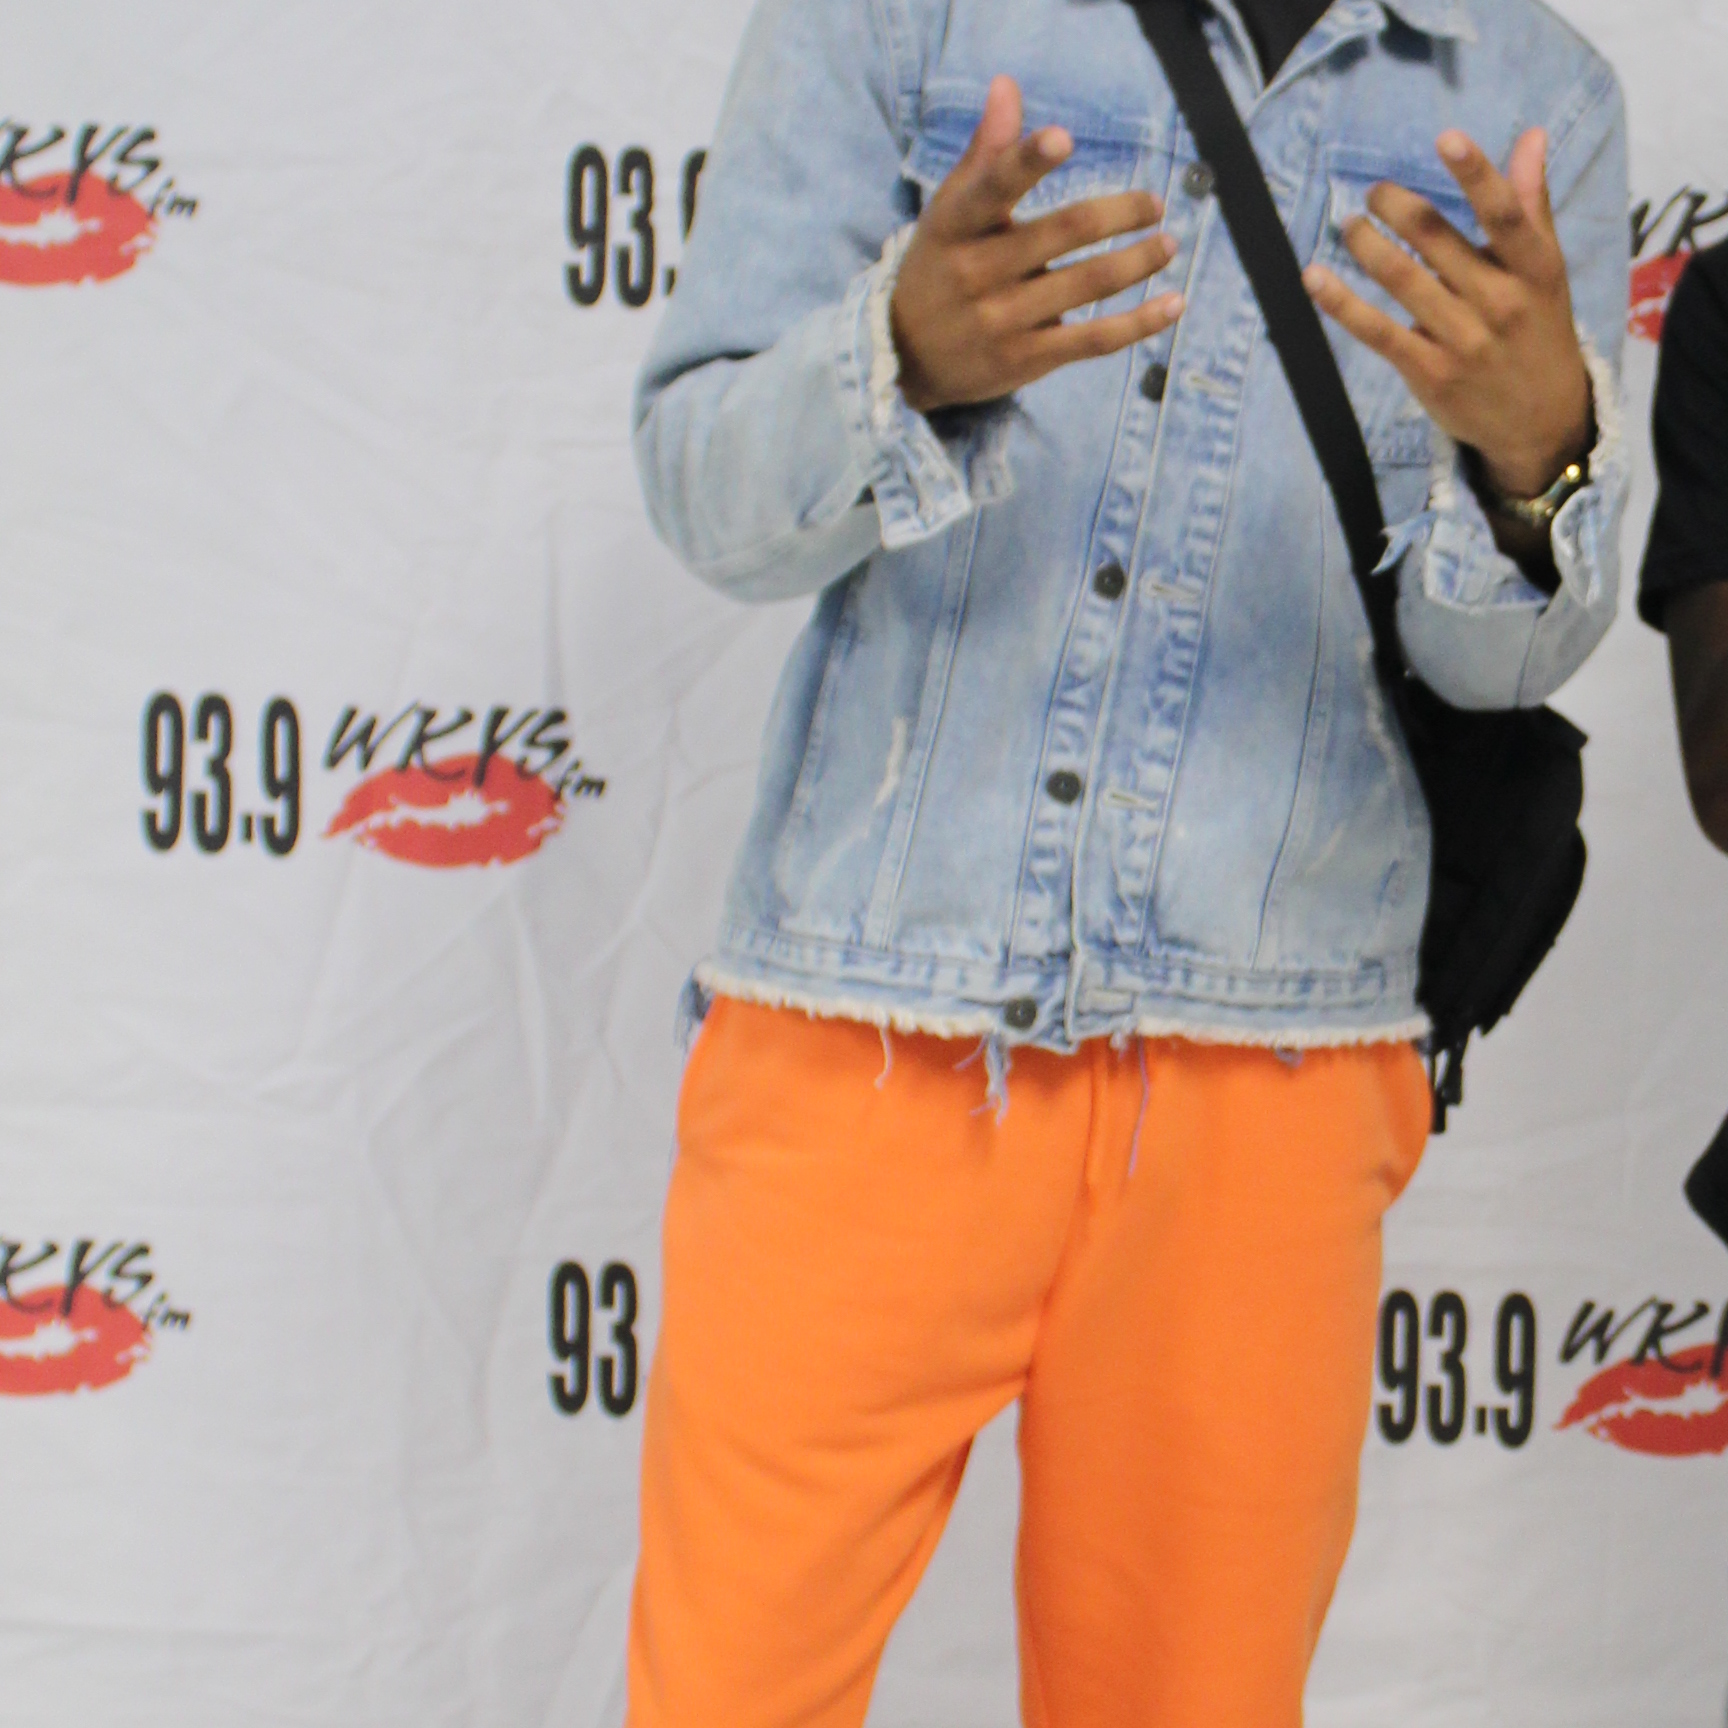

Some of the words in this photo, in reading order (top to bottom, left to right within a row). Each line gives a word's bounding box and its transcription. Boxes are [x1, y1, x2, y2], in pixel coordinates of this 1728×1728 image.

[0, 118, 162, 203] KYS
[142, 692, 300, 856] 93.9
[324, 707, 569, 788] WKYS
[0, 1237, 154, 1316] KYS
[1376, 1289, 1537, 1450] 93.9
